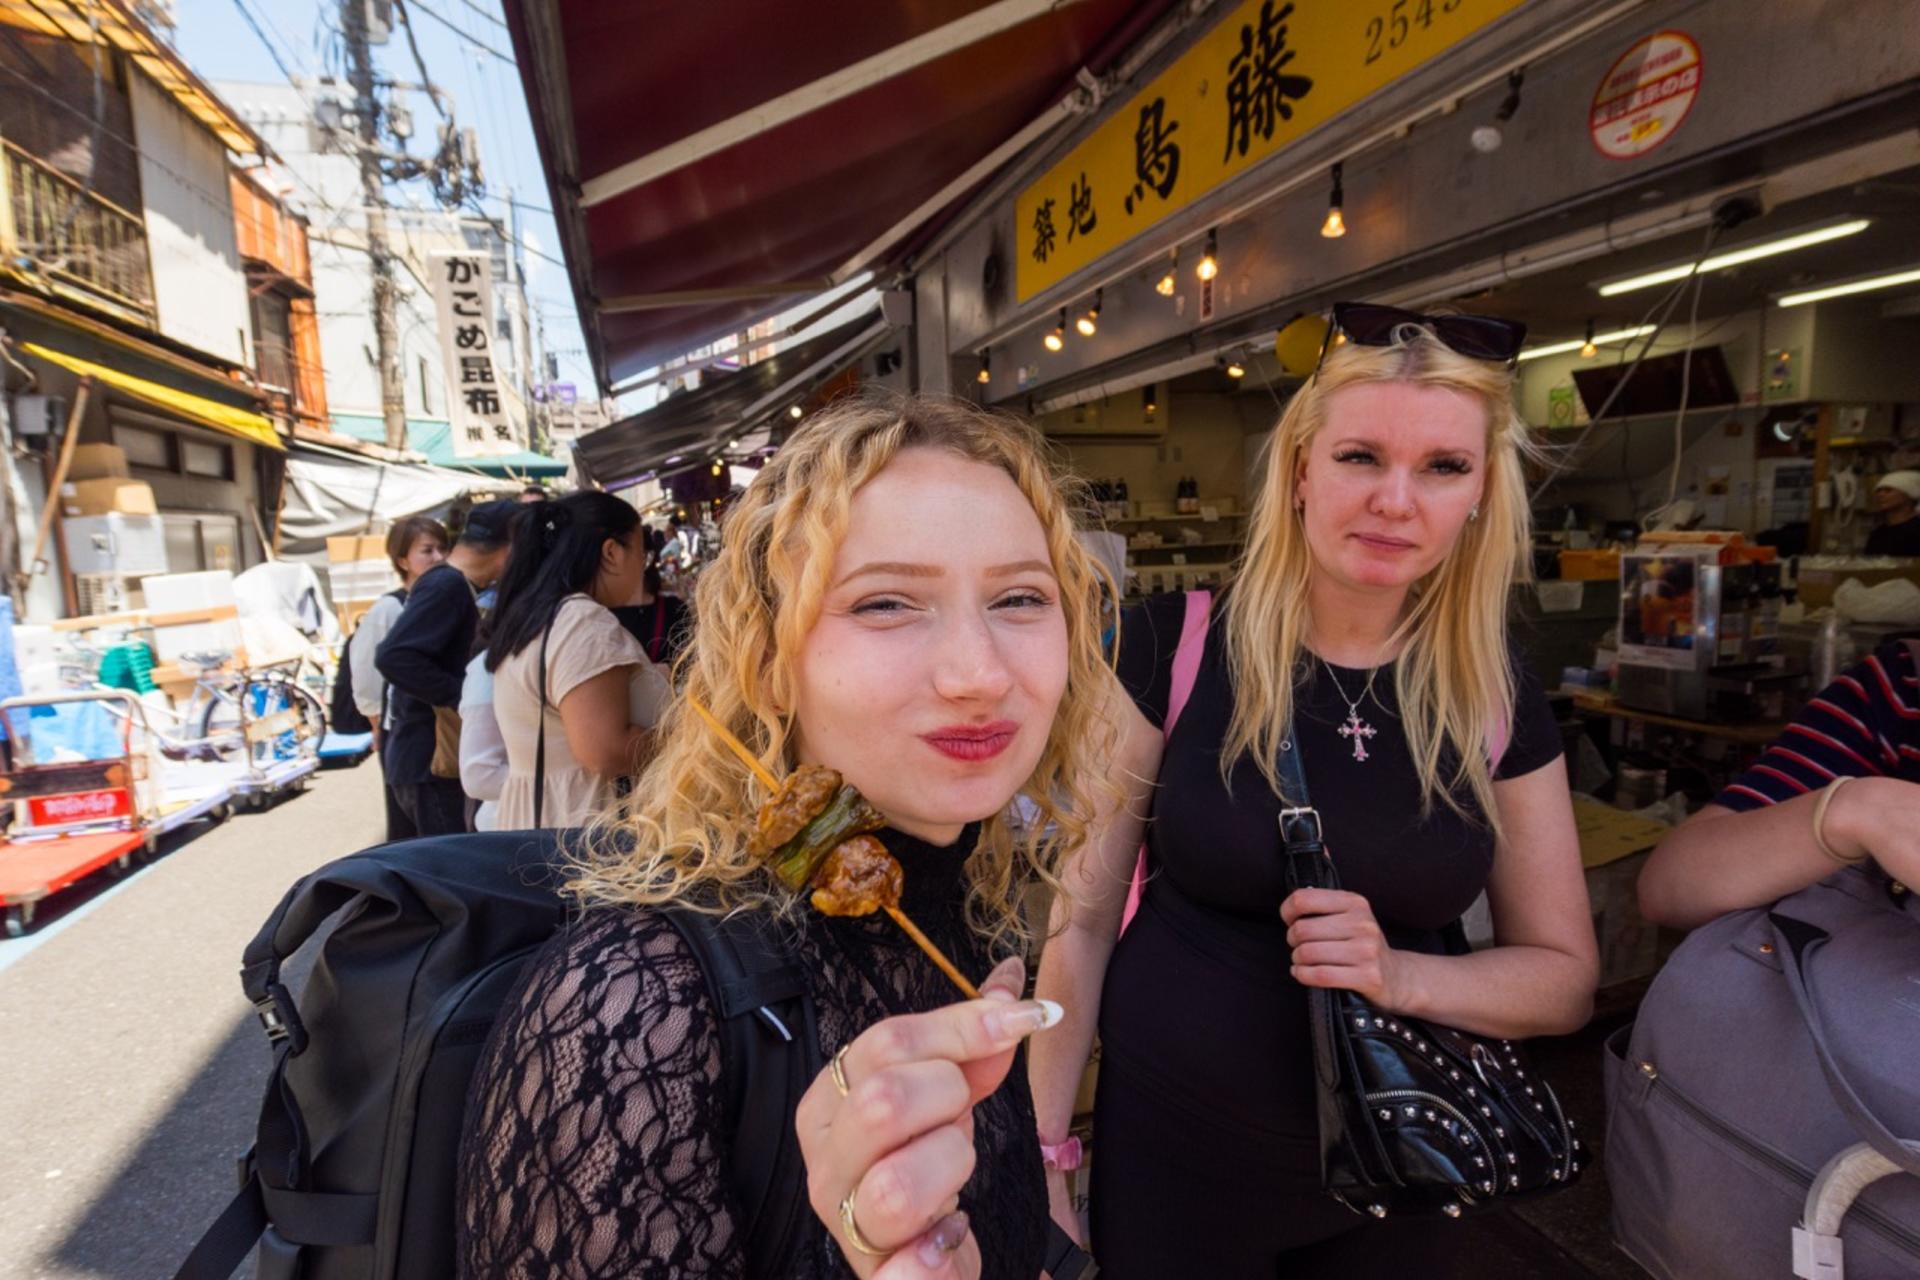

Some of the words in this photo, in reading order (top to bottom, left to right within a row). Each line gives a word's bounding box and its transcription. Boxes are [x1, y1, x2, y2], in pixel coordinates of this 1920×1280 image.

[1364, 0, 1463, 65] 254
[1032, 171, 1097, 263] 築地
[445, 256, 501, 416] がごめ昆布
